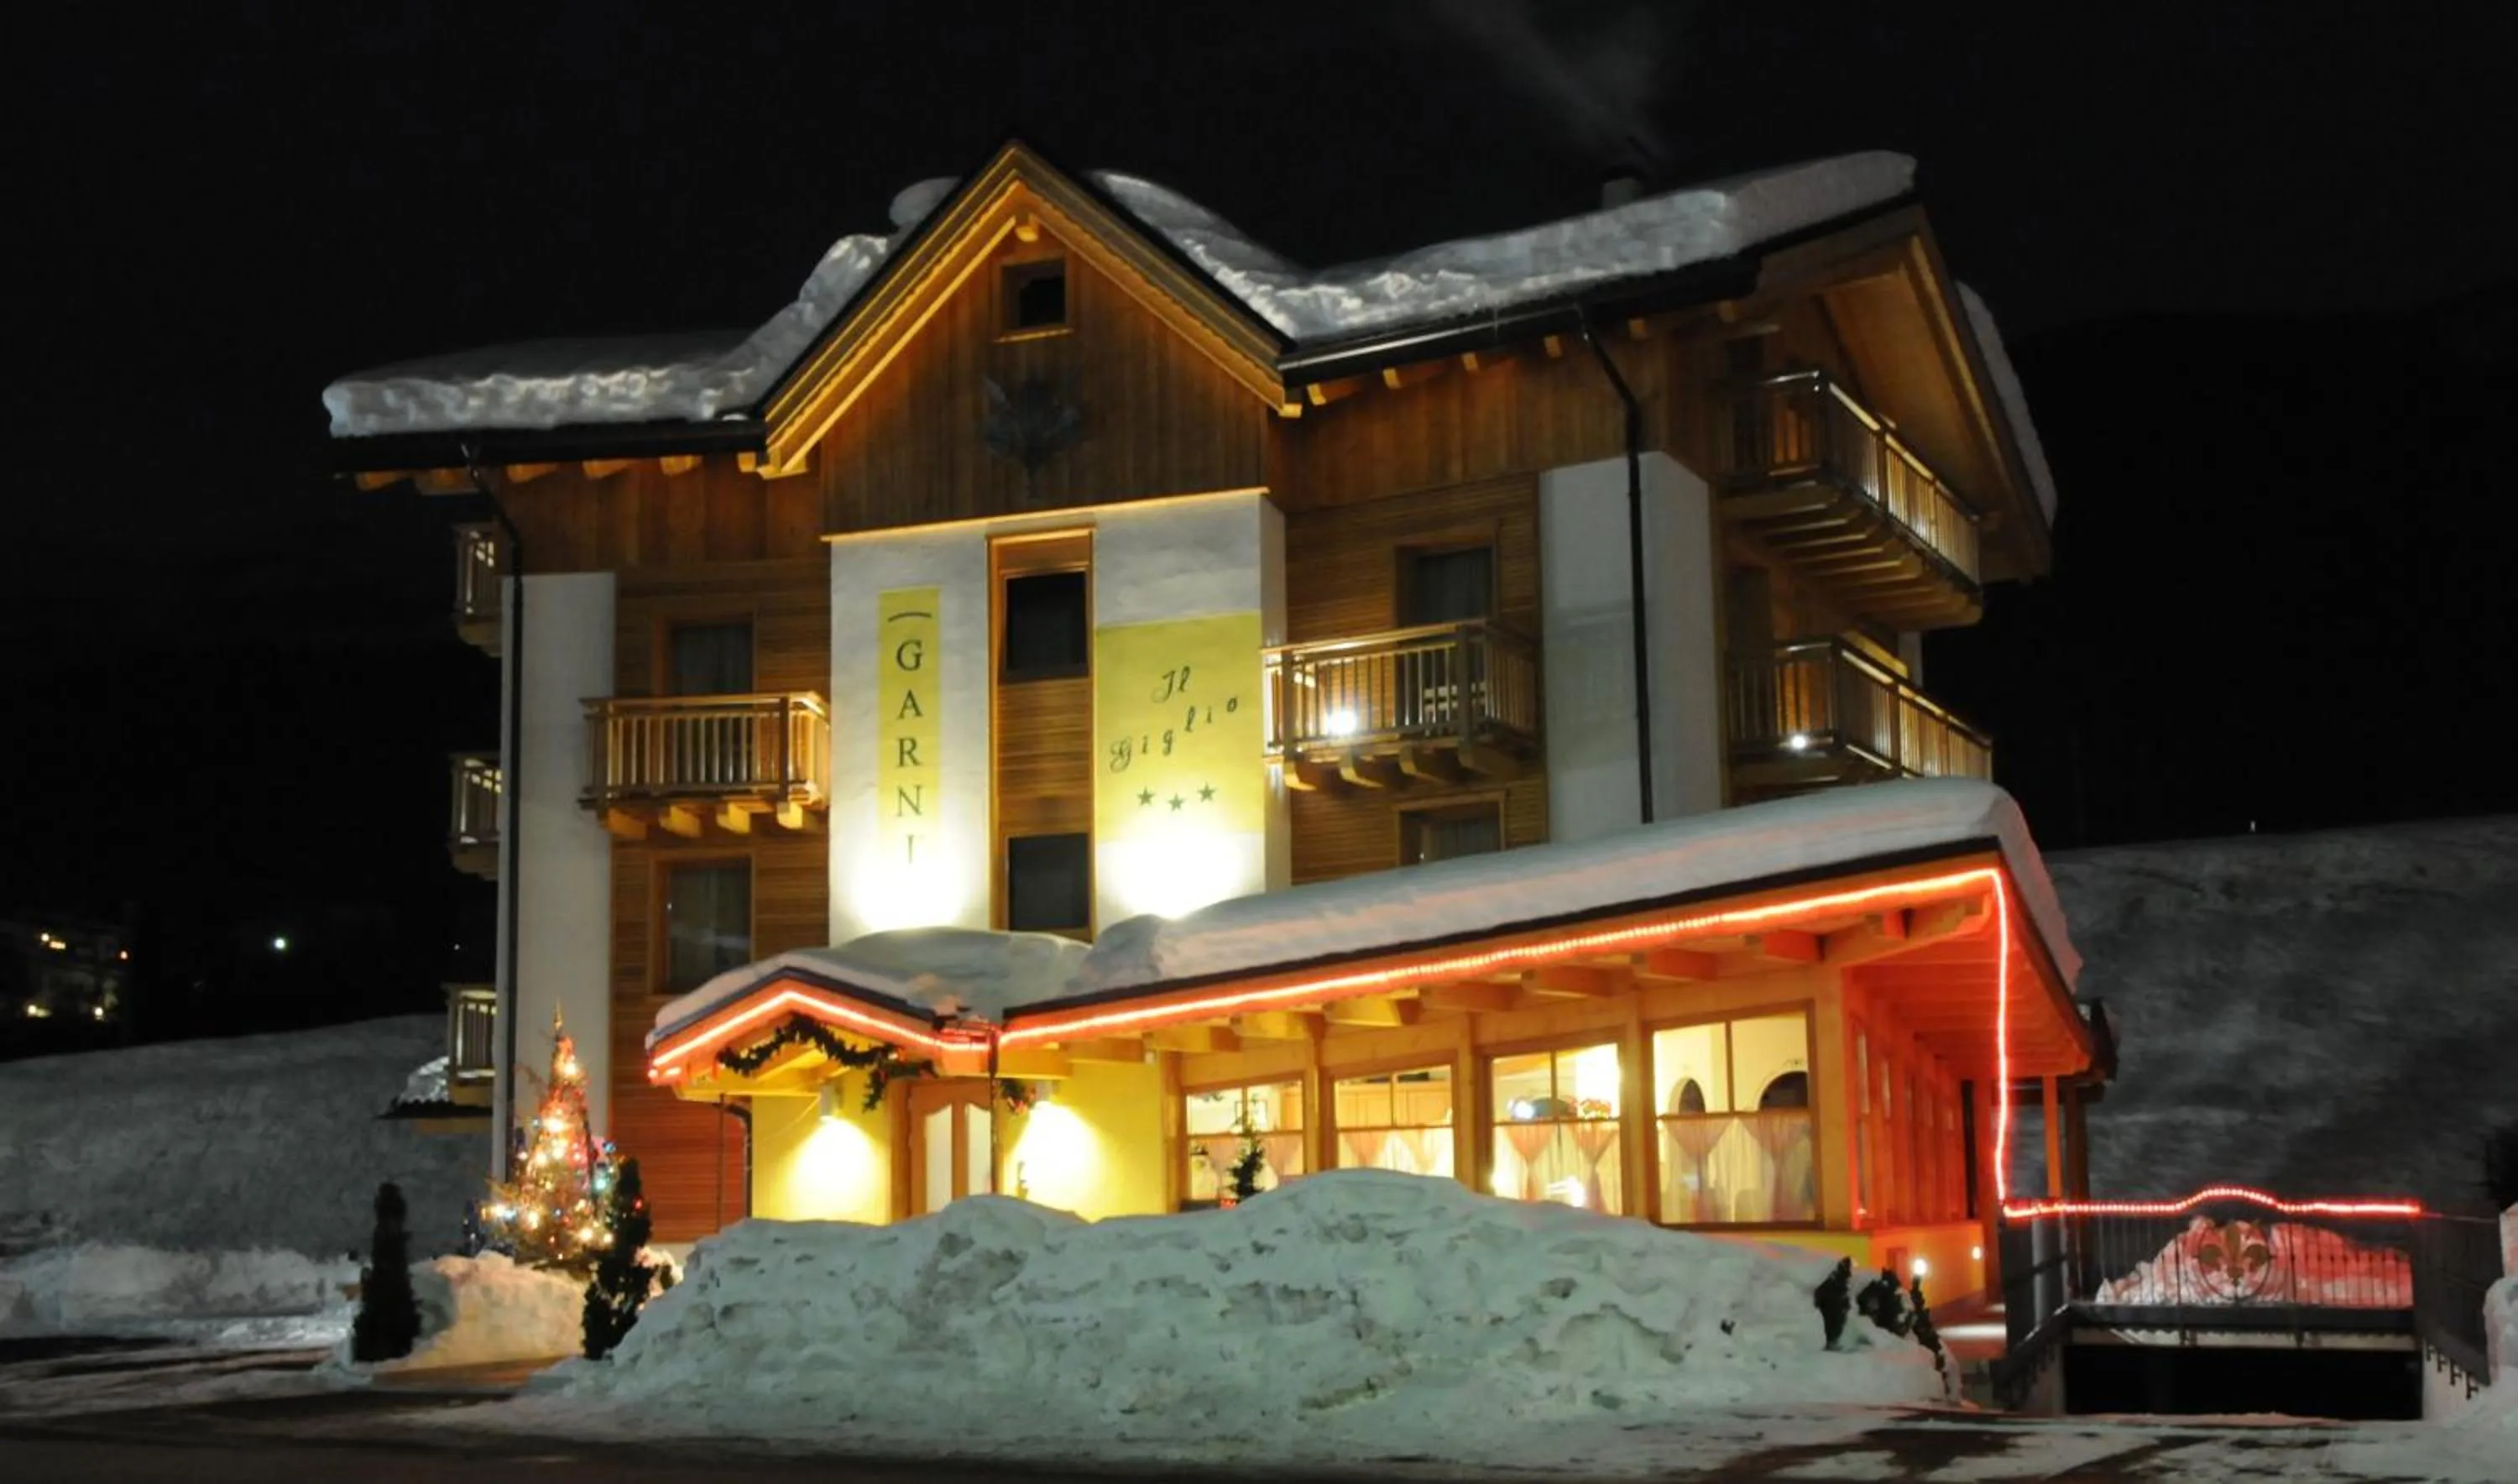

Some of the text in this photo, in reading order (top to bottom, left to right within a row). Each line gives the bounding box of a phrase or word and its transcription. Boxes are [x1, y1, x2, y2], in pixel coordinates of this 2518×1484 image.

[1151, 665, 1191, 703] Il
[896, 639, 923, 865] GARNI
[1109, 696, 1239, 774] Giglio
